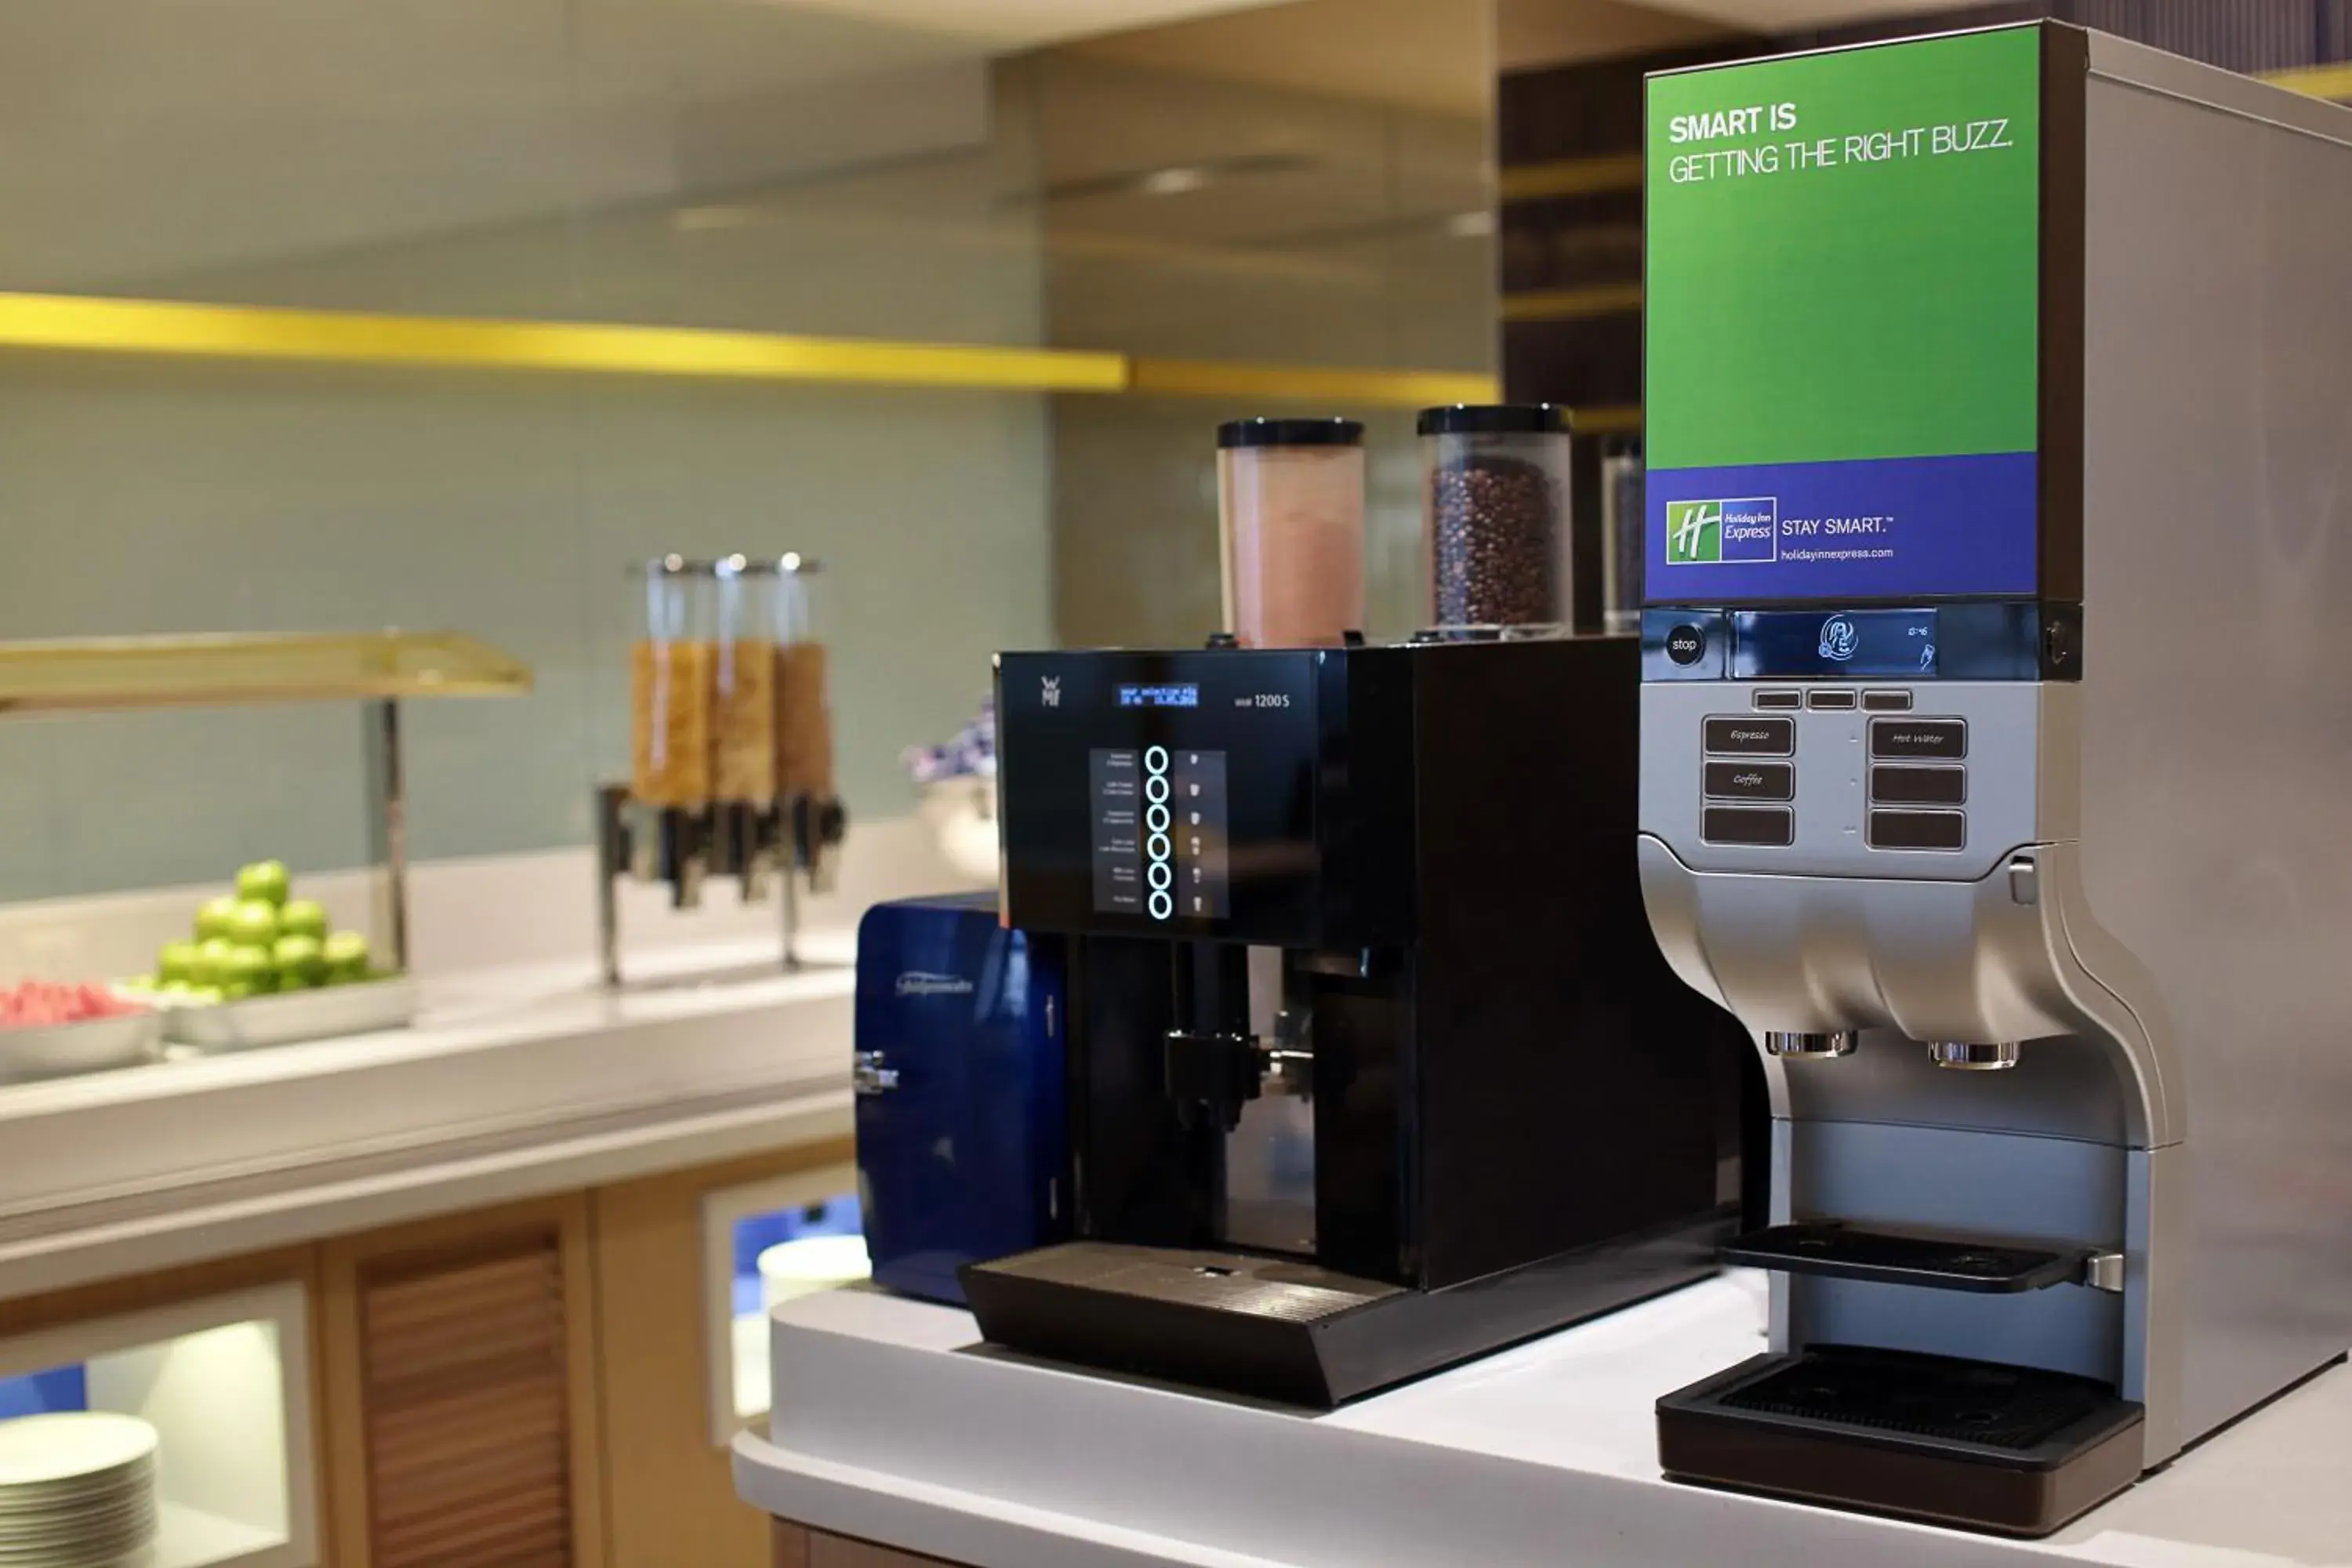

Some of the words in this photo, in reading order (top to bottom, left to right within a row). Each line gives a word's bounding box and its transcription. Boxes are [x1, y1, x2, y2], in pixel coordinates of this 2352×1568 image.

[1669, 107, 1763, 143] SMART
[1770, 103, 1797, 130] IS
[1669, 145, 1778, 183] GETTING
[1785, 139, 1837, 169] THE
[1845, 129, 1926, 164] RIGHT
[1932, 118, 2013, 154] BUZZ.
[1726, 514, 1757, 524] Holiday
[1757, 512, 1771, 523] Inn
[1725, 525, 1771, 543] Express
[1781, 519, 1820, 535] STAY
[1780, 549, 1894, 562] holidayinnexpress.com
[1673, 640, 1697, 652] stop
[1255, 694, 1281, 707] 1200
[1730, 730, 1769, 744] Espresso
[1733, 773, 1762, 787] Coffee
